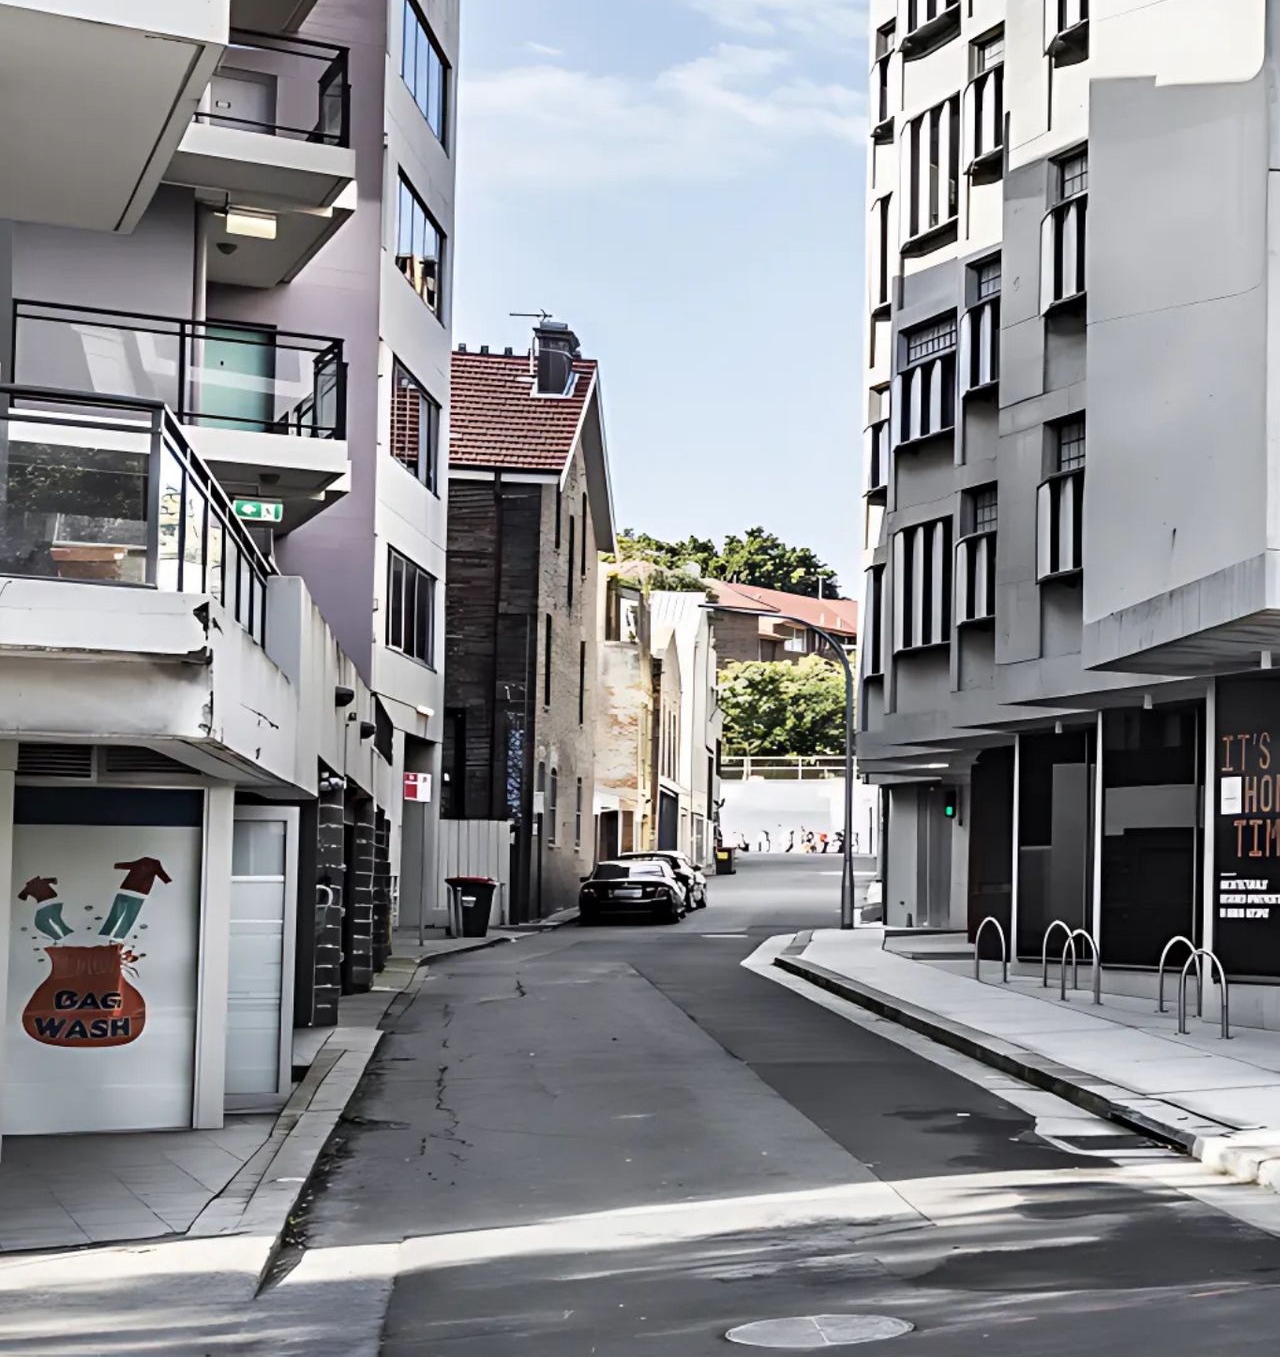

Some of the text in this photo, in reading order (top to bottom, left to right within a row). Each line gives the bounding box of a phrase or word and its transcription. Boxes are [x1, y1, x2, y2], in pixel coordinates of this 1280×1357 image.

[1221, 732, 1271, 771] IT'S
[53, 990, 123, 1011] BAG
[34, 1015, 132, 1039] WASH
